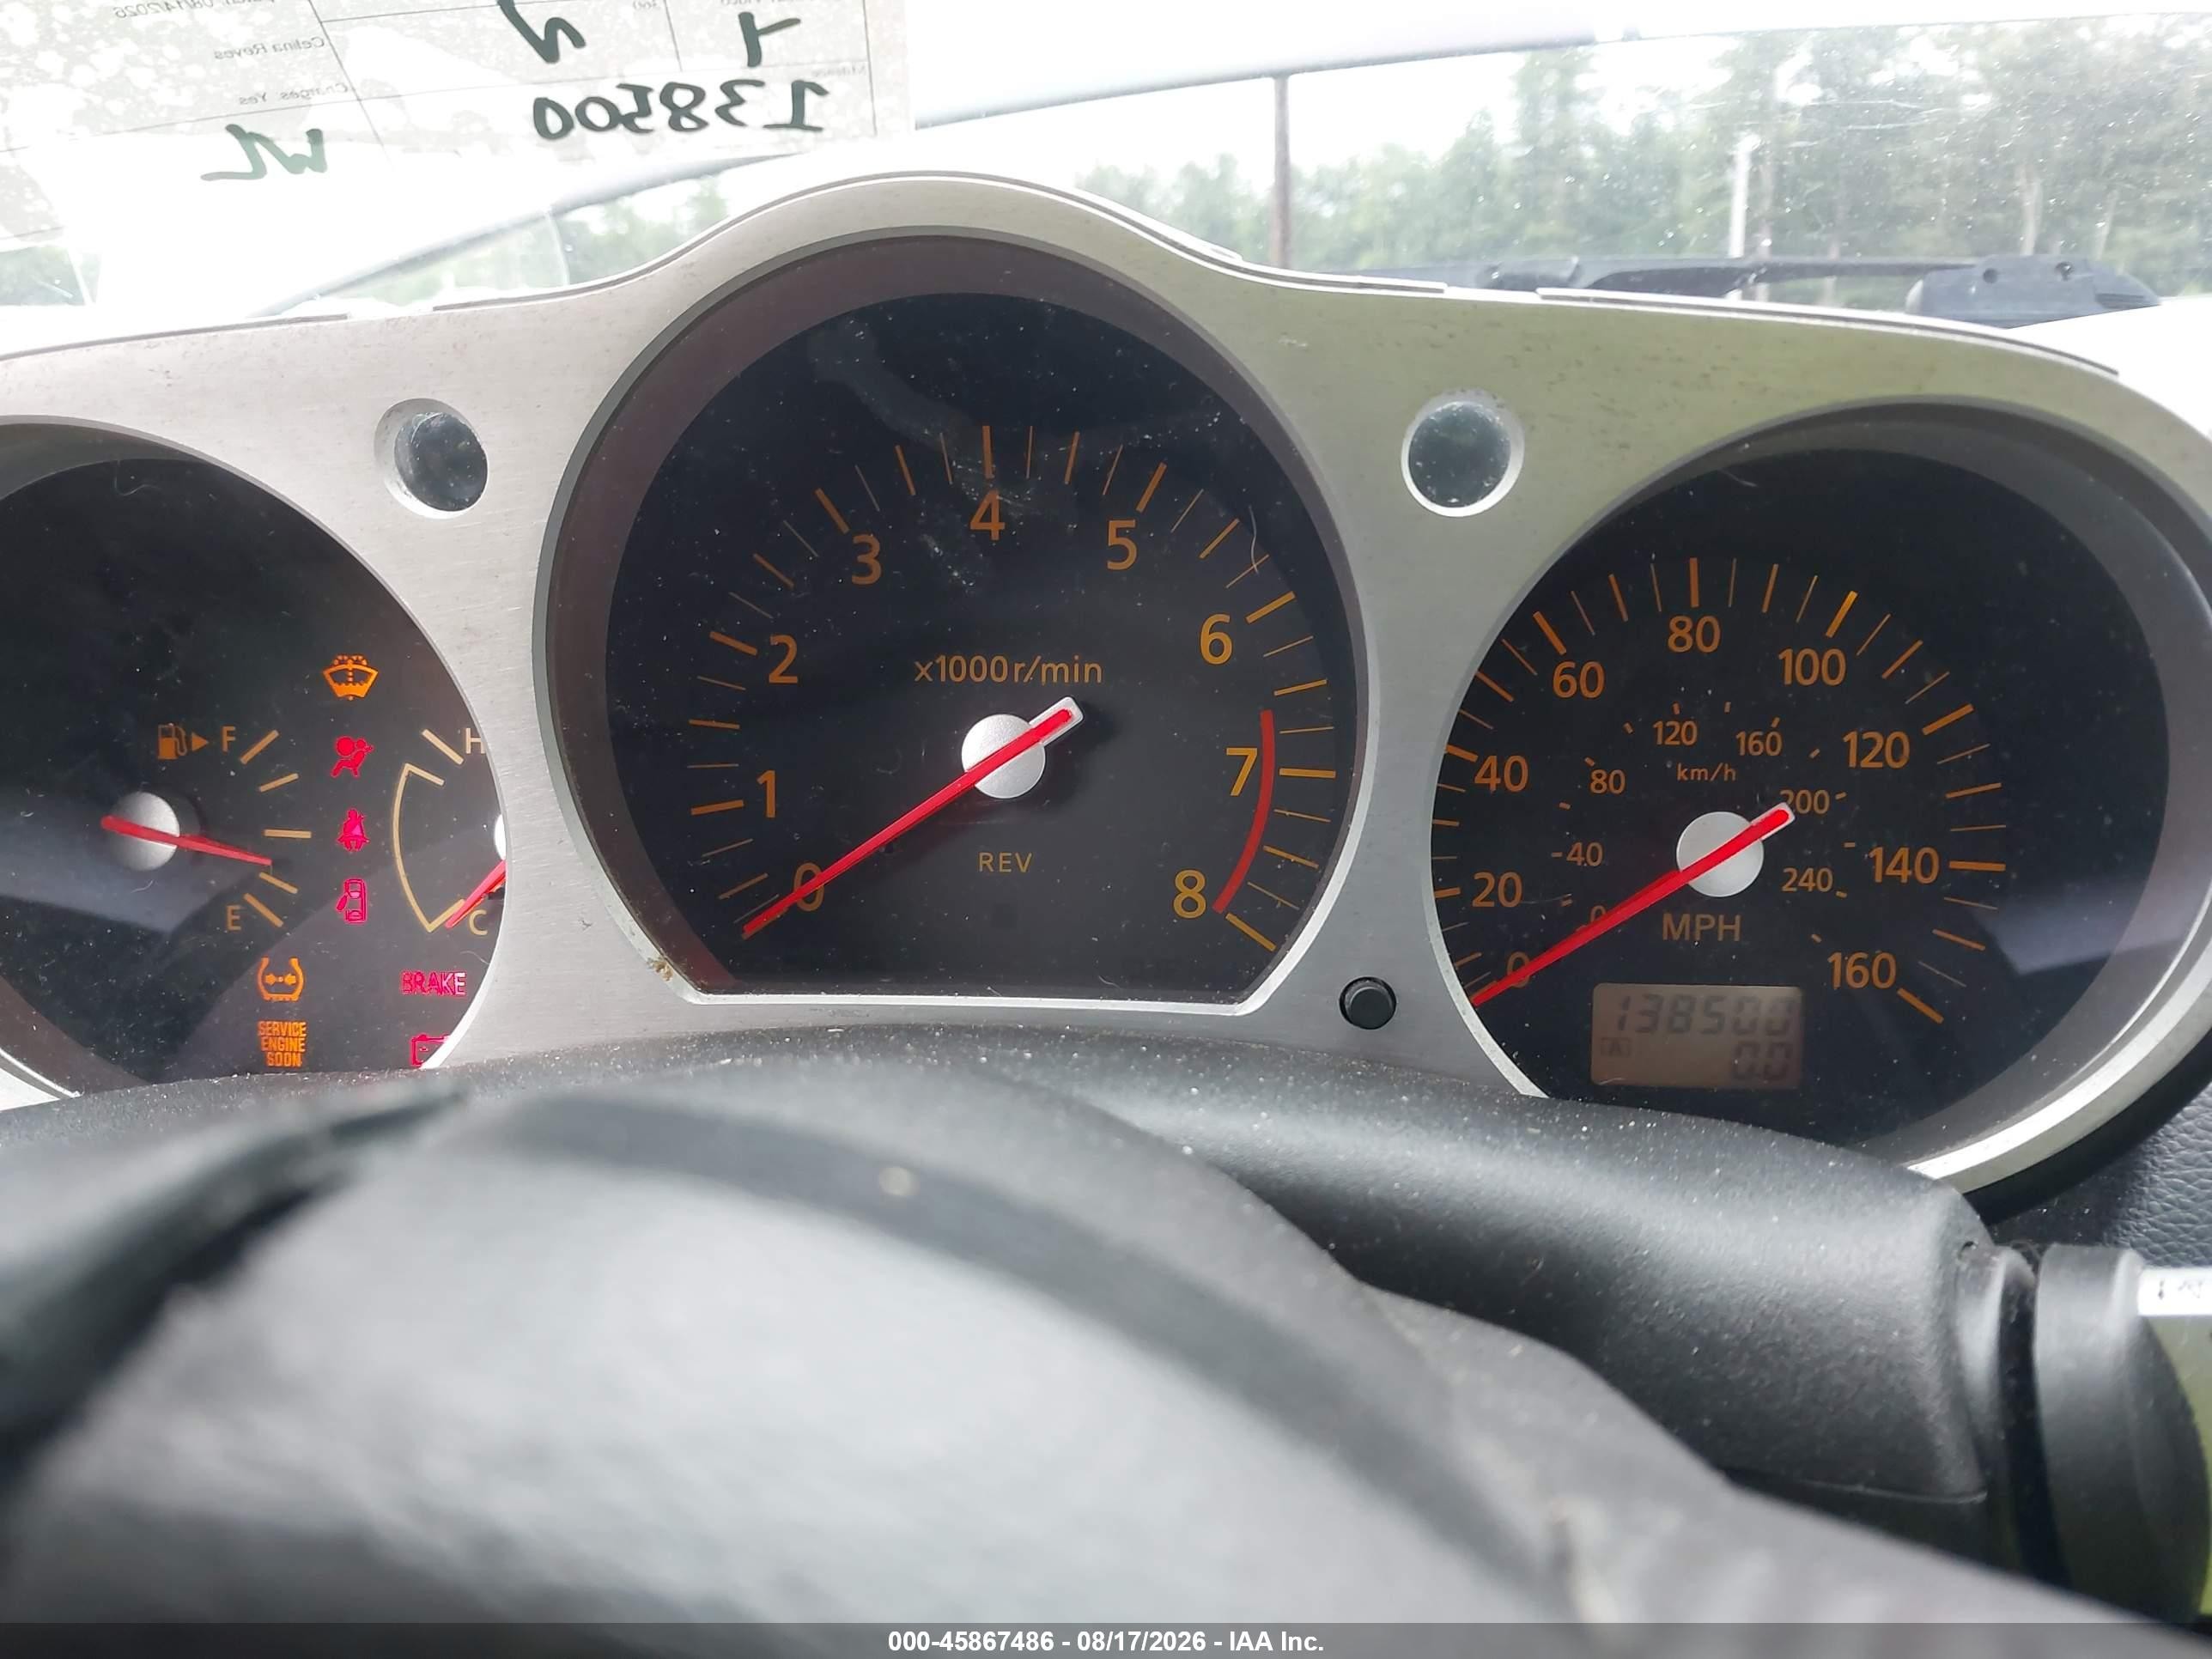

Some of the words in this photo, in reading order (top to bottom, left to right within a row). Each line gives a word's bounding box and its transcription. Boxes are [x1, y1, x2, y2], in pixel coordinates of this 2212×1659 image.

[970, 492, 1005, 540] 4
[852, 534, 882, 584] 3
[1108, 520, 1137, 570] 5
[1200, 614, 1231, 665] 6
[1668, 616, 1720, 653] 80
[768, 635, 799, 684] 2
[1778, 648, 1846, 686] 100
[1553, 661, 1605, 698] 60
[222, 726, 235, 752] F
[465, 728, 486, 754] H
[1653, 721, 1698, 746] 120
[1736, 731, 1782, 757] 160
[1843, 732, 1910, 769] 120
[1226, 748, 1257, 796] 7
[1474, 756, 1528, 792] 40
[1590, 770, 1626, 794] 80
[1677, 763, 1736, 782] km/h
[758, 770, 776, 817] 1
[978, 853, 1032, 872] REV
[1566, 842, 1603, 866] 40
[1869, 848, 1939, 884] 140
[794, 864, 825, 911] 0
[1174, 870, 1206, 918] 8
[1472, 872, 1522, 908] 20
[1782, 867, 1833, 892] 240
[227, 906, 241, 930] E
[468, 909, 488, 935] C
[1662, 914, 1741, 941] MPH
[402, 970, 466, 996] BRAKE
[1506, 951, 1530, 988] 0
[1828, 952, 1897, 989] 160
[258, 1020, 307, 1037] SERVICE
[1618, 994, 1797, 1036] 138500
[260, 1036, 306, 1052] ENGINE
[266, 1052, 302, 1067] SOON
